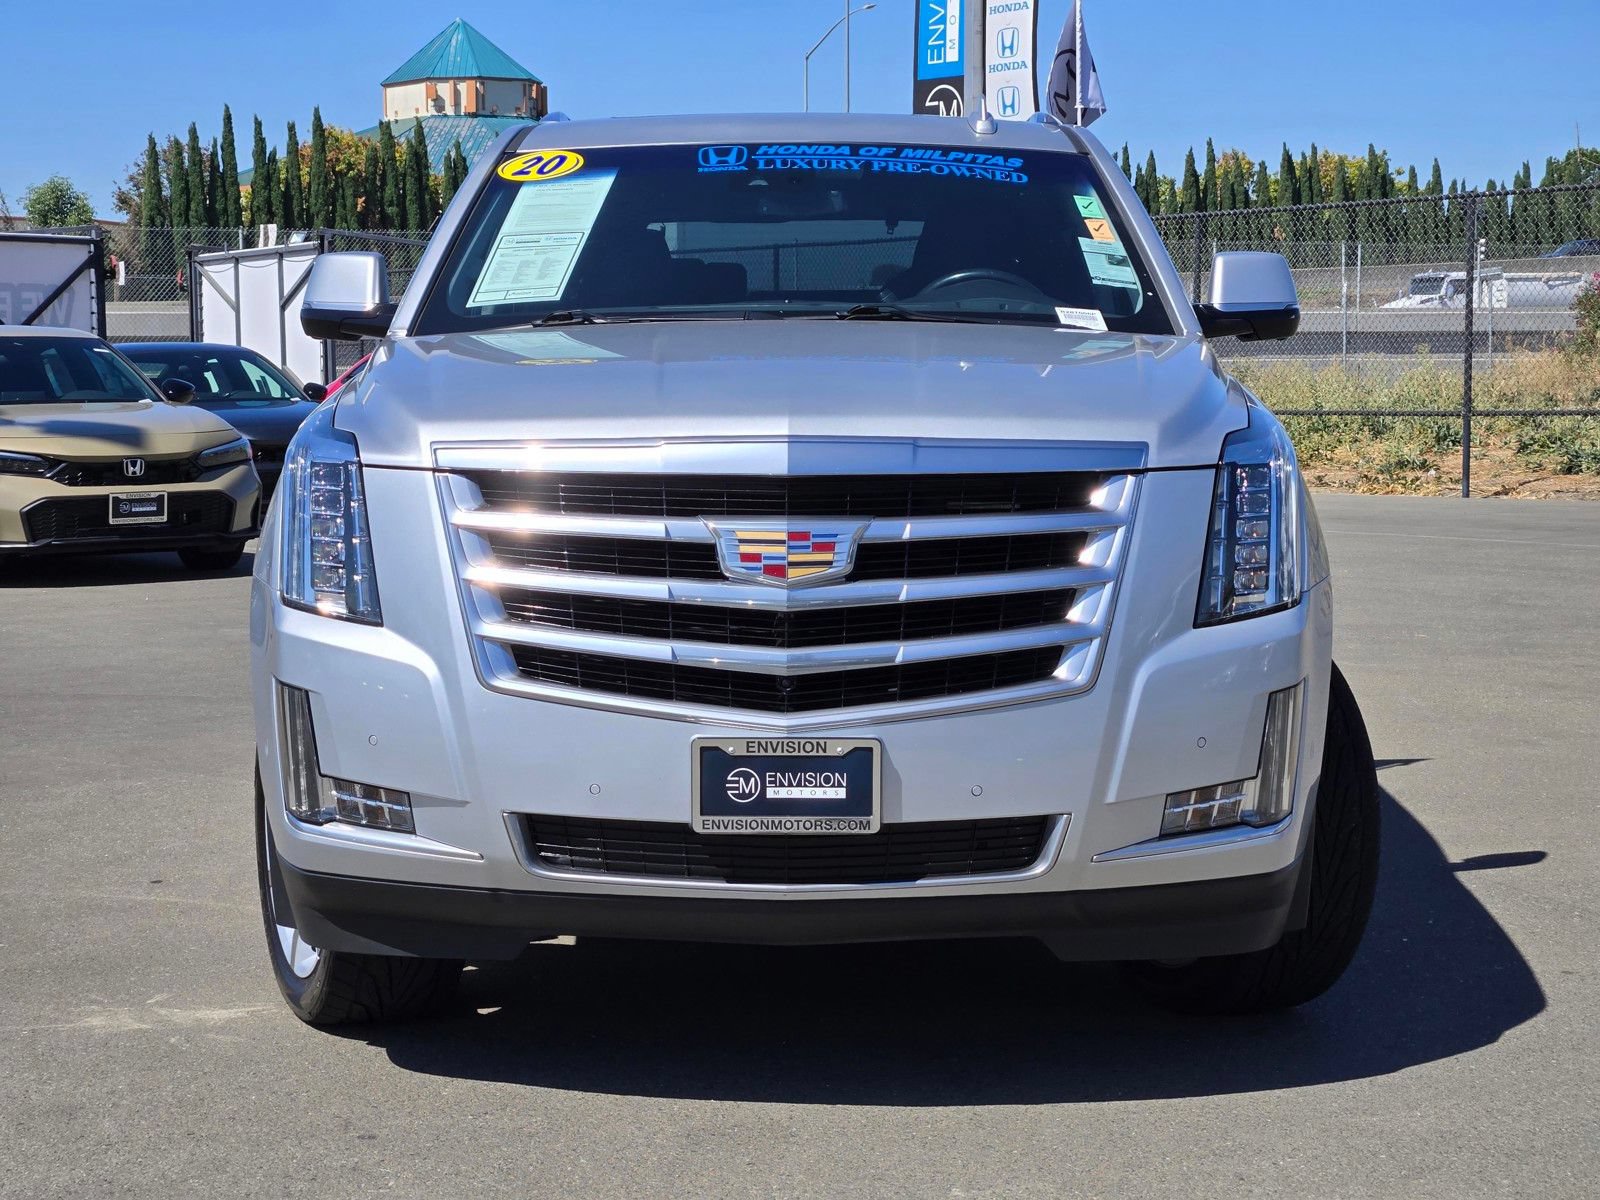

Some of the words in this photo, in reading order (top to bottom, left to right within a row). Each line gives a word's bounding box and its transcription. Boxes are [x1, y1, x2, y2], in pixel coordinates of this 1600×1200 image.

[989, 1, 1029, 15] HONDA
[988, 60, 1028, 73] HONDA
[756, 145, 850, 155] HONDA
[858, 146, 896, 157] OF
[899, 148, 1024, 168] MILPITAS
[511, 154, 568, 176] 20
[756, 158, 865, 170] LUXURY
[870, 159, 1029, 183] PRE-OWNED
[746, 740, 827, 754] ENVISION
[765, 772, 847, 788] ENVISION
[702, 819, 871, 831] ENVISIONMOTORS.COM
